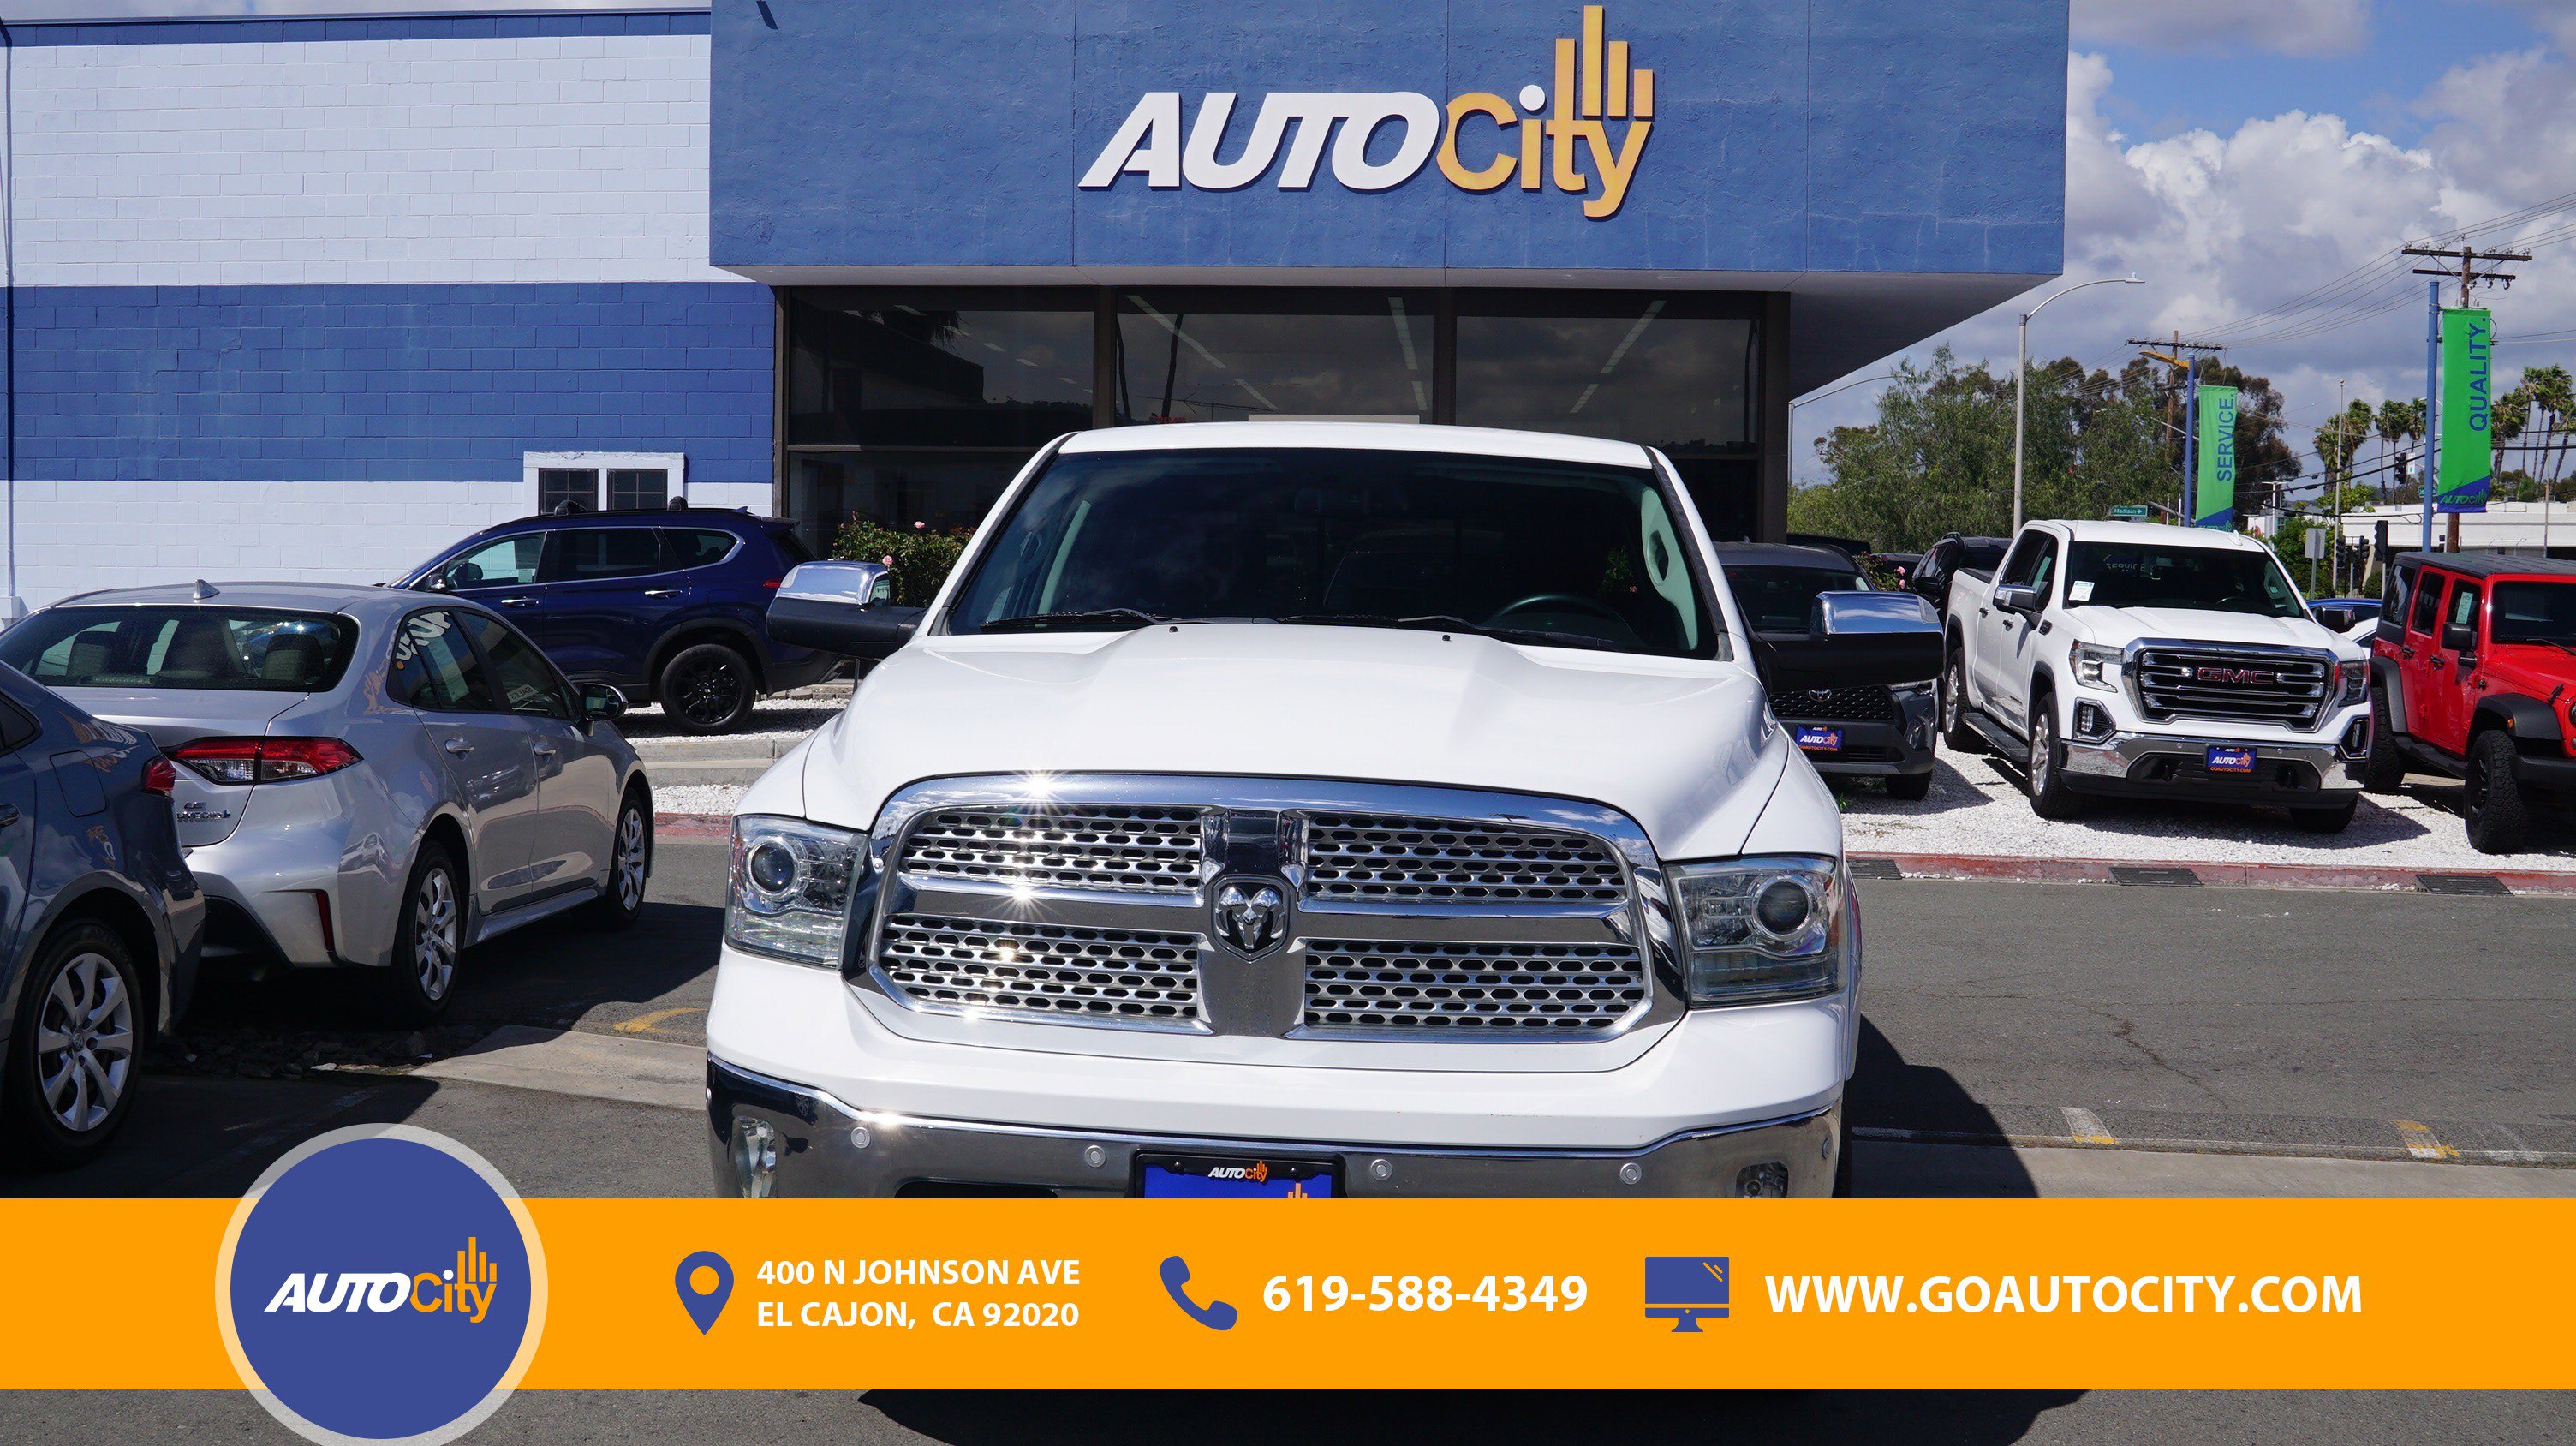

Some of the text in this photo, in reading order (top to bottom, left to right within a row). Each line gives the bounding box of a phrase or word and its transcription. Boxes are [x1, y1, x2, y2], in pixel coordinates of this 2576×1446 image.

[2469, 317, 2489, 432] QUALITY.
[2216, 394, 2234, 481] SERVICE.
[2197, 667, 2275, 684] GMC
